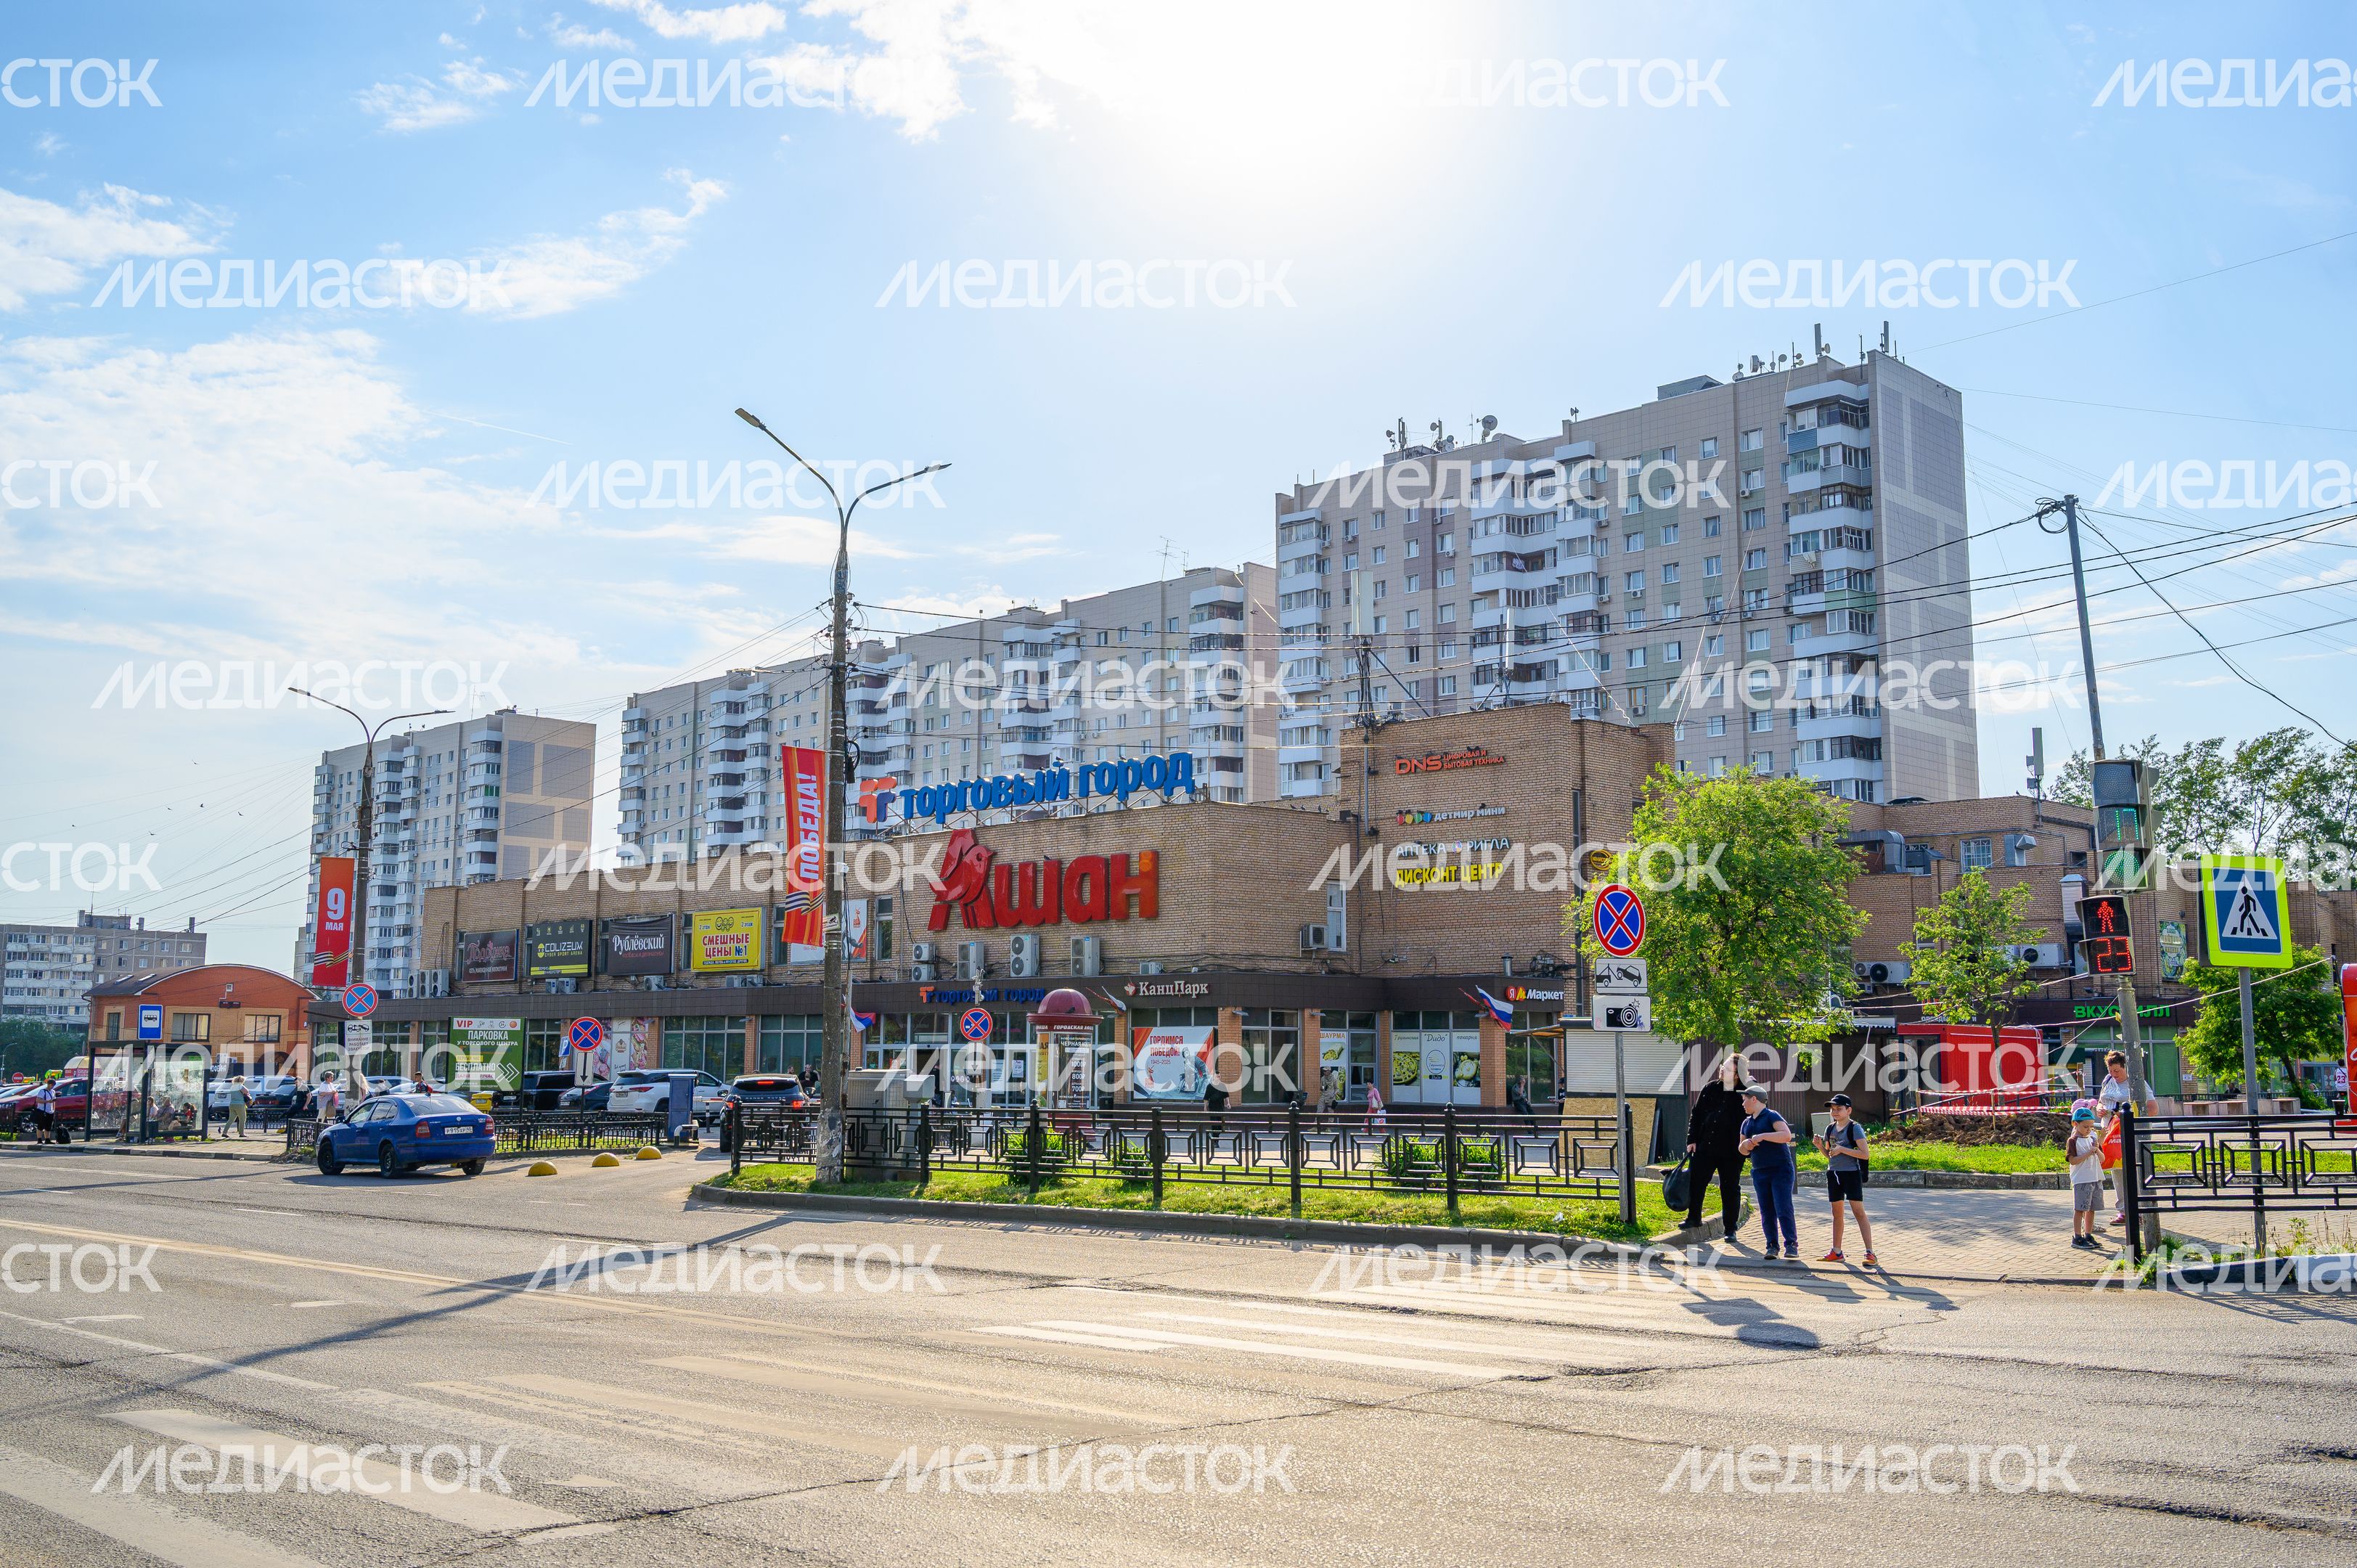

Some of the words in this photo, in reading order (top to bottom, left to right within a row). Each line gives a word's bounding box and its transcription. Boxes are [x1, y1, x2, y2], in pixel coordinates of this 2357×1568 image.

[1444, 751, 1480, 761] ЦИФРОВАЯ
[1444, 759, 1474, 769] БЫТОВАЯ
[1474, 756, 1504, 766] ТЕХНИКА
[1395, 755, 1442, 775] DNS
[899, 759, 1069, 824] торговый
[1079, 751, 1196, 801] город
[1434, 809, 1476, 821] детмир
[1476, 807, 1506, 817] мини
[796, 772, 821, 880] ПОБЕДА!
[1396, 843, 1447, 857] АПТЕКА
[1466, 838, 1510, 851] РИГЛА
[927, 828, 1160, 931] Ашан
[1394, 865, 1458, 888] ДИСКОНТ
[1461, 862, 1503, 883] ЦЕНТР
[327, 887, 346, 920] 9
[325, 922, 343, 931] МАЯ
[545, 941, 583, 952] COLIZEUM
[613, 933, 664, 955] Рублёвский
[702, 934, 749, 946] СМЕШНЫЕ
[706, 947, 732, 959] ЦЕНЫ
[2096, 936, 2132, 972] 23
[1005, 987, 1046, 1005] город
[1139, 981, 1209, 998] КанцПарк
[1527, 989, 1564, 1001] Маркет
[2074, 1005, 2170, 1018] ВКУСИЛЛ
[468, 1031, 508, 1040] ПАРКОВКА
[1150, 1035, 1183, 1046] ГОРДИМСЯ
[1150, 1047, 1180, 1058] ПОБЕДОЙ!
[455, 1062, 496, 1071] БЕСПЛАТНО
